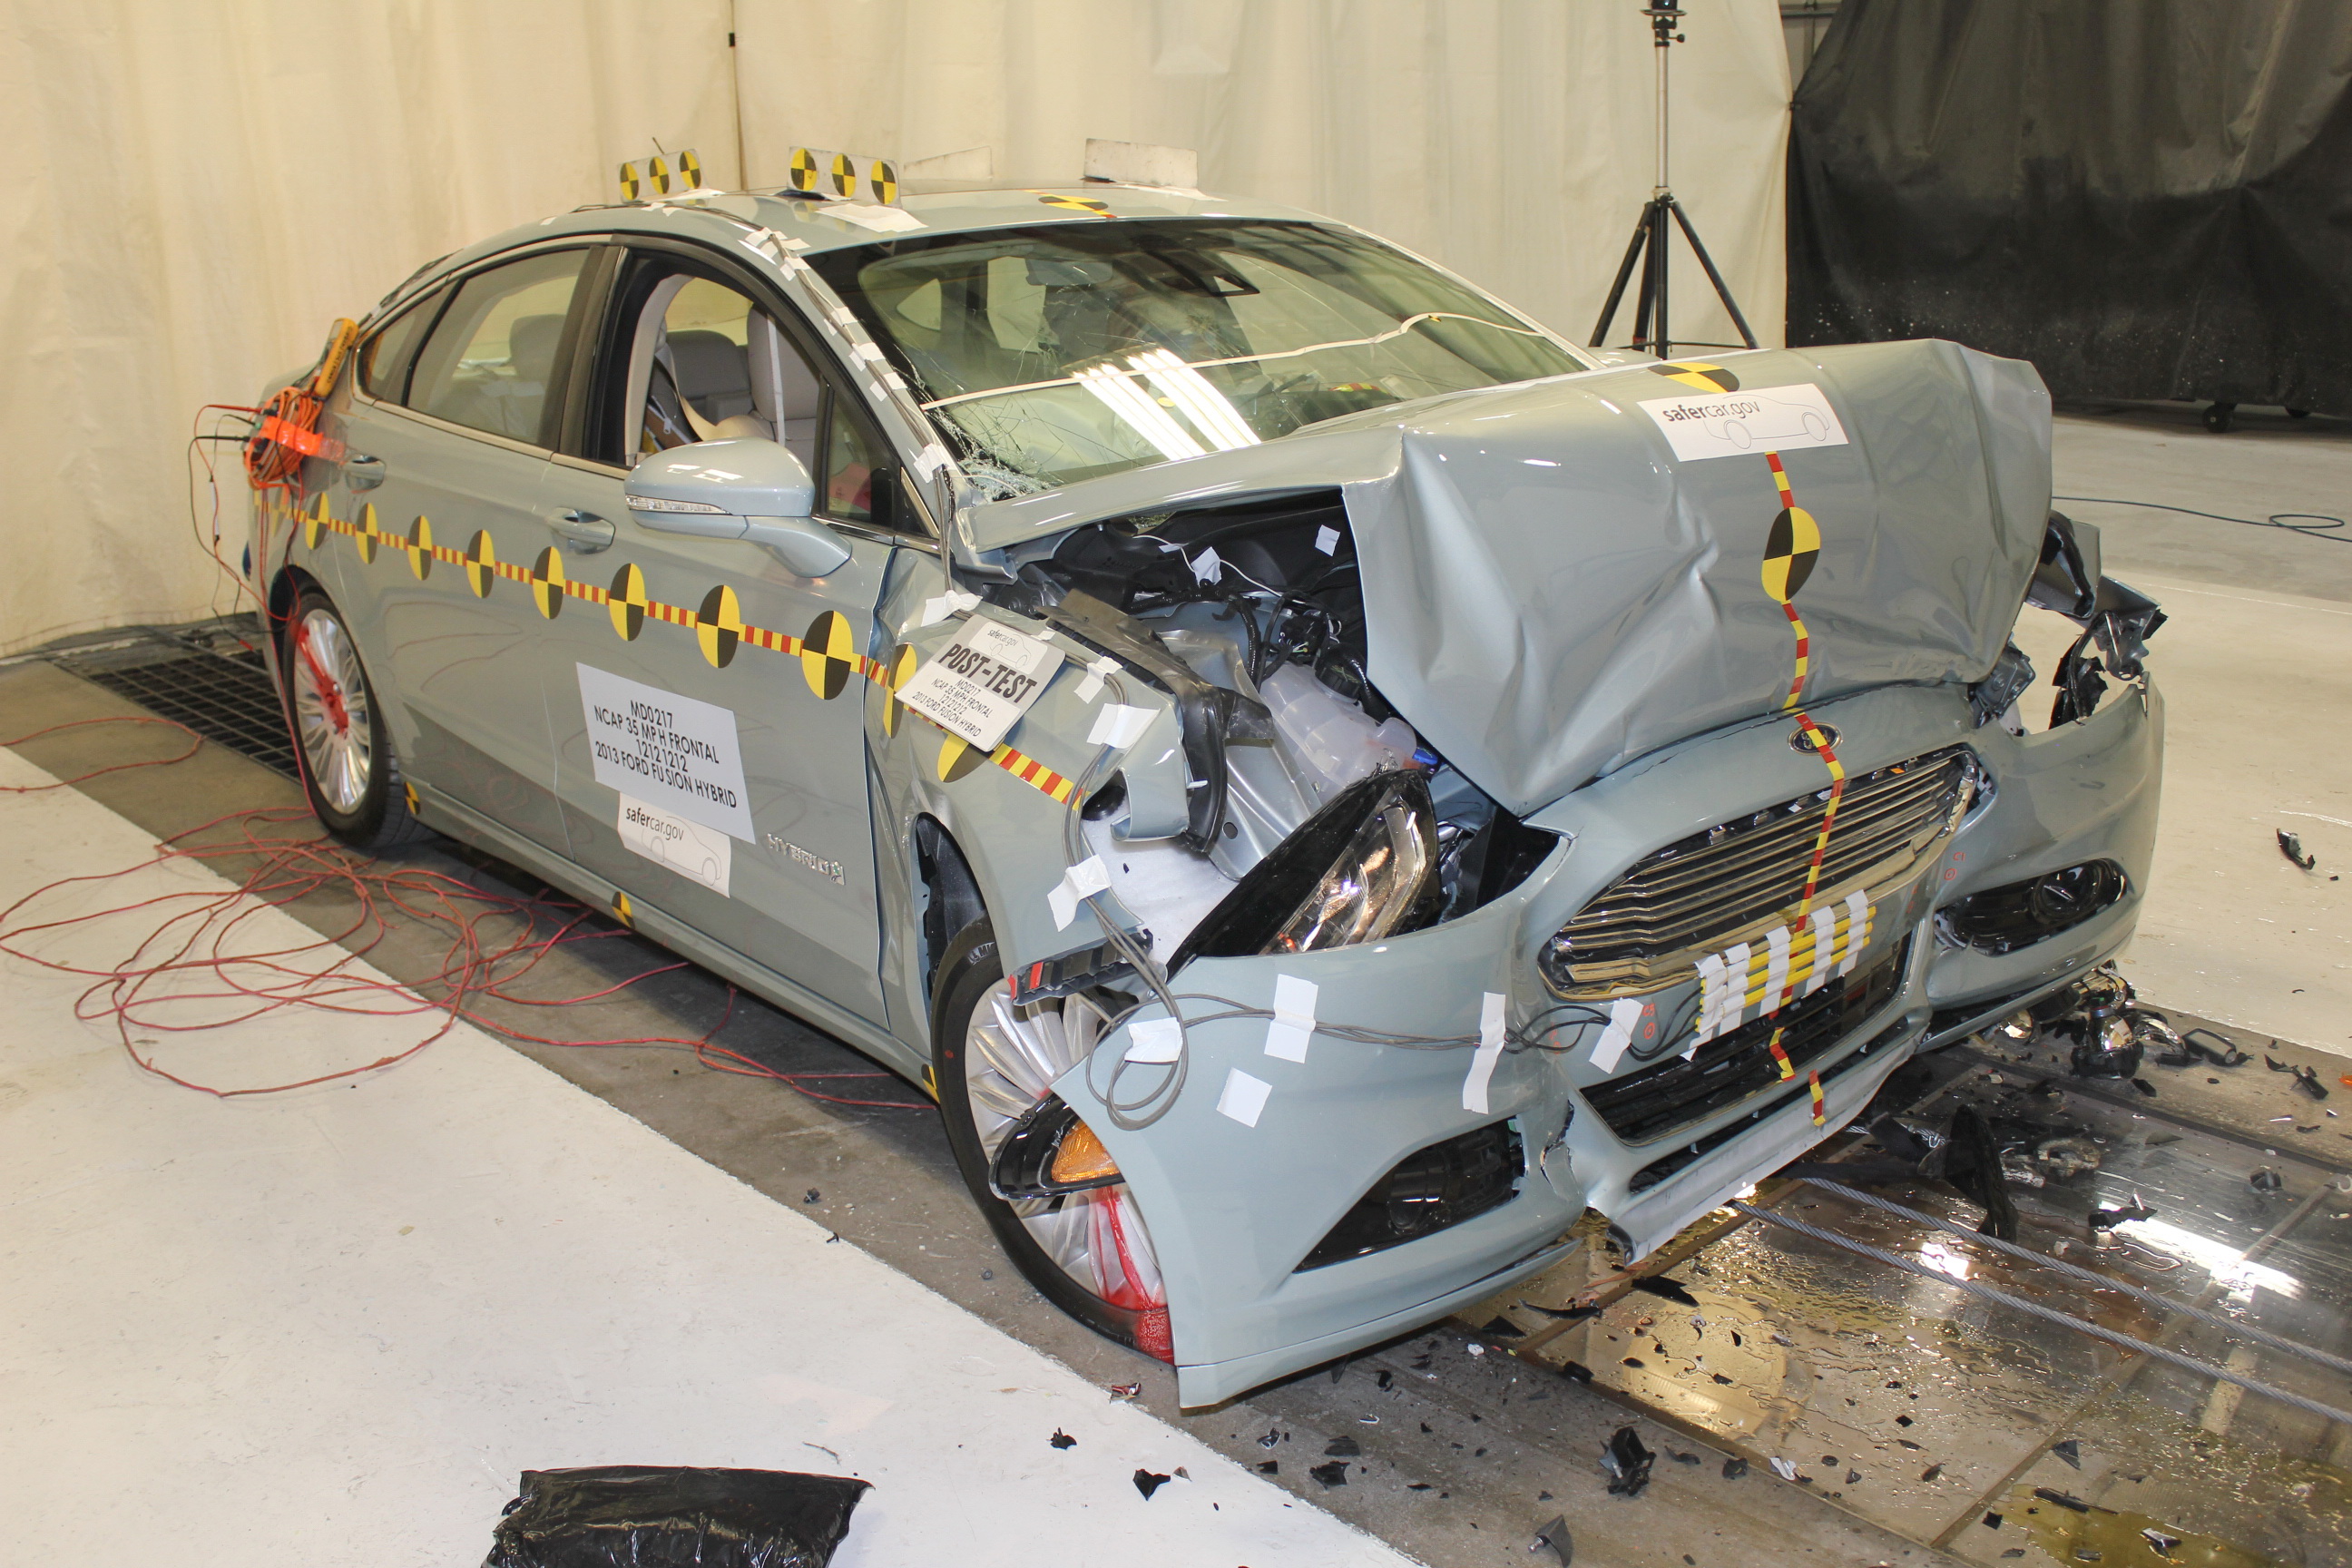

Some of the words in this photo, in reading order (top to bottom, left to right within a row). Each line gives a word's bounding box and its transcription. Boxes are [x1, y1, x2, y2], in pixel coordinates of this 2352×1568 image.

[1662, 401, 1760, 421] safercar.gov
[987, 629, 1019, 646] safercar.gov
[938, 643, 1037, 704] POST-TEST
[956, 679, 981, 697] MD0217
[630, 700, 673, 729] MD0217
[912, 691, 927, 703] 2013
[924, 698, 941, 711] FORD
[937, 706, 961, 724] FUSION
[957, 719, 982, 737] HYBRID
[931, 678, 948, 690] NCAP
[946, 685, 956, 694] 35
[952, 690, 968, 703] MPH
[965, 697, 993, 718] FRONTAL
[593, 705, 623, 730] NCAP
[625, 717, 639, 736] 35
[641, 723, 667, 746] MPH
[668, 731, 720, 764] FRONTAL
[594, 740, 620, 765] 2013
[621, 750, 649, 776] FORD
[651, 761, 693, 794] FUSION
[695, 780, 737, 808] HYBRID
[636, 739, 688, 772] 12121212
[625, 806, 684, 841] safercar.gov
[767, 833, 830, 876] HYBRID
